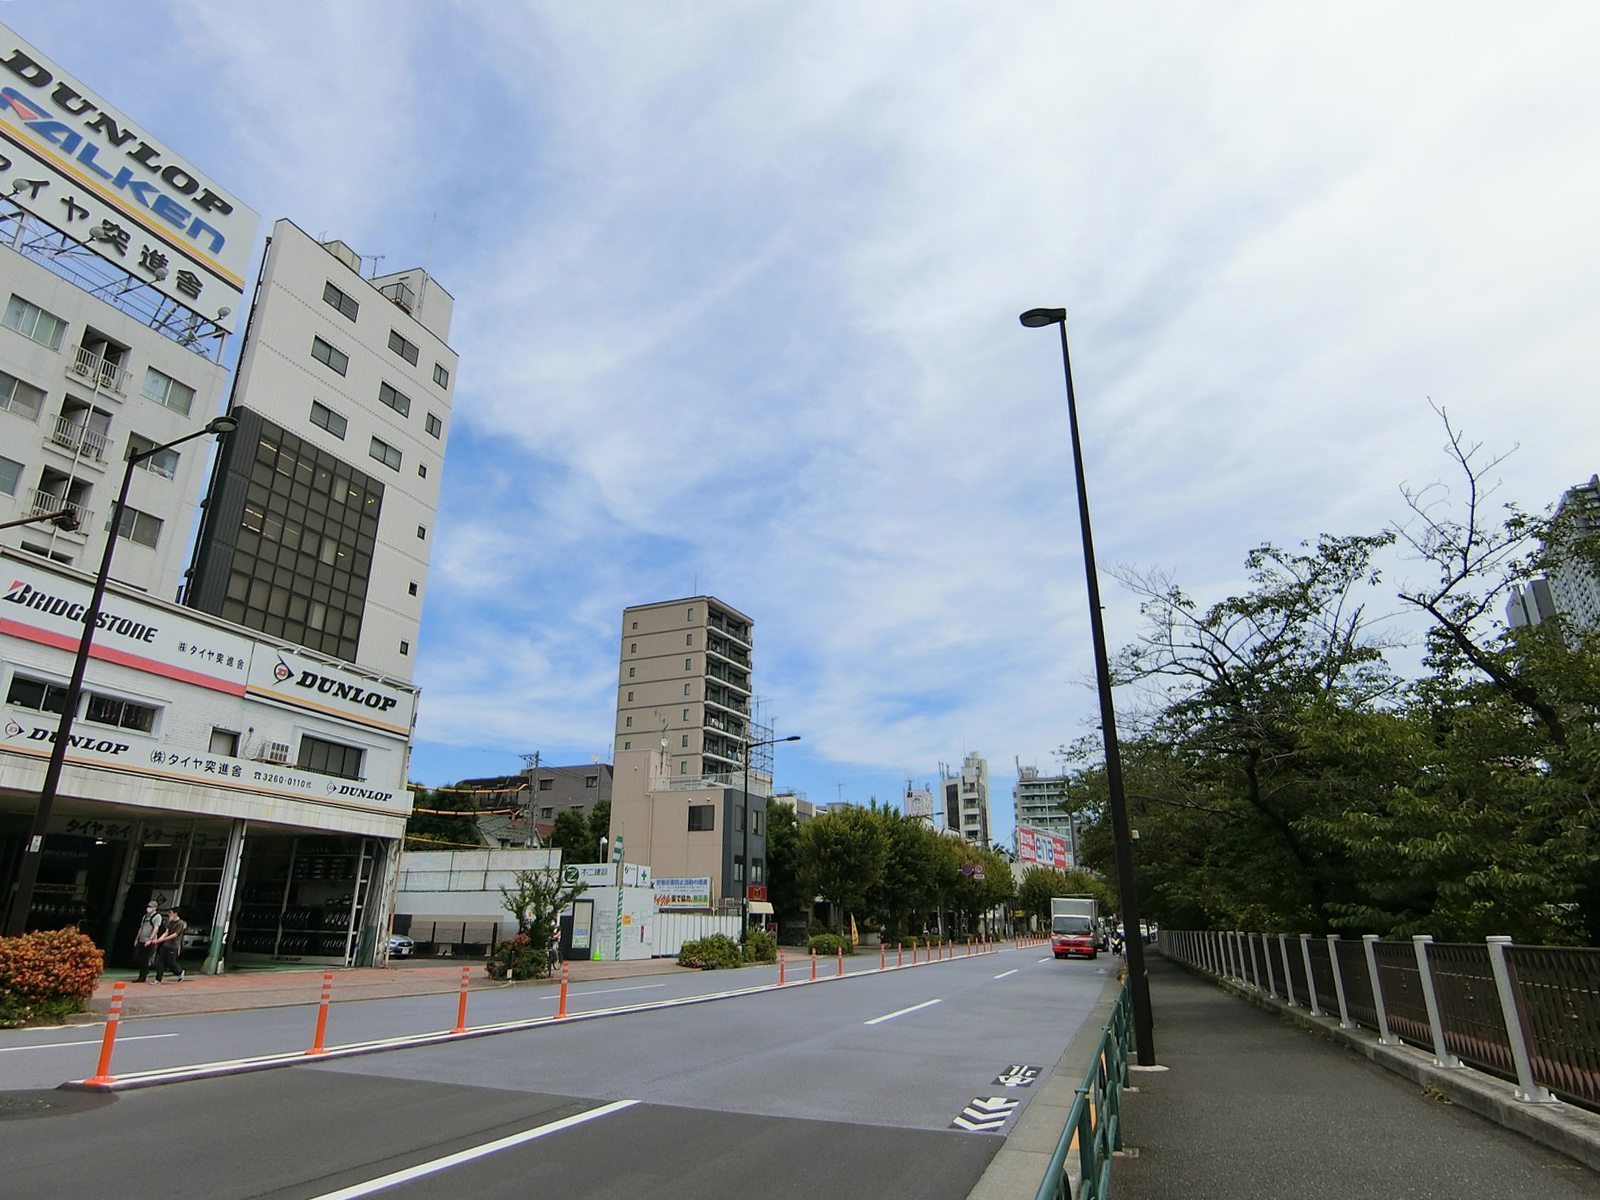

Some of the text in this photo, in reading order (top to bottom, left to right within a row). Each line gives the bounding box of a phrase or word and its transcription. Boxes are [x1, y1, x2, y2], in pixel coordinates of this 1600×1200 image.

[0, 49, 233, 215] DUNLOP
[296, 670, 397, 711] DUNLOP
[338, 785, 393, 802] DUNLOP
